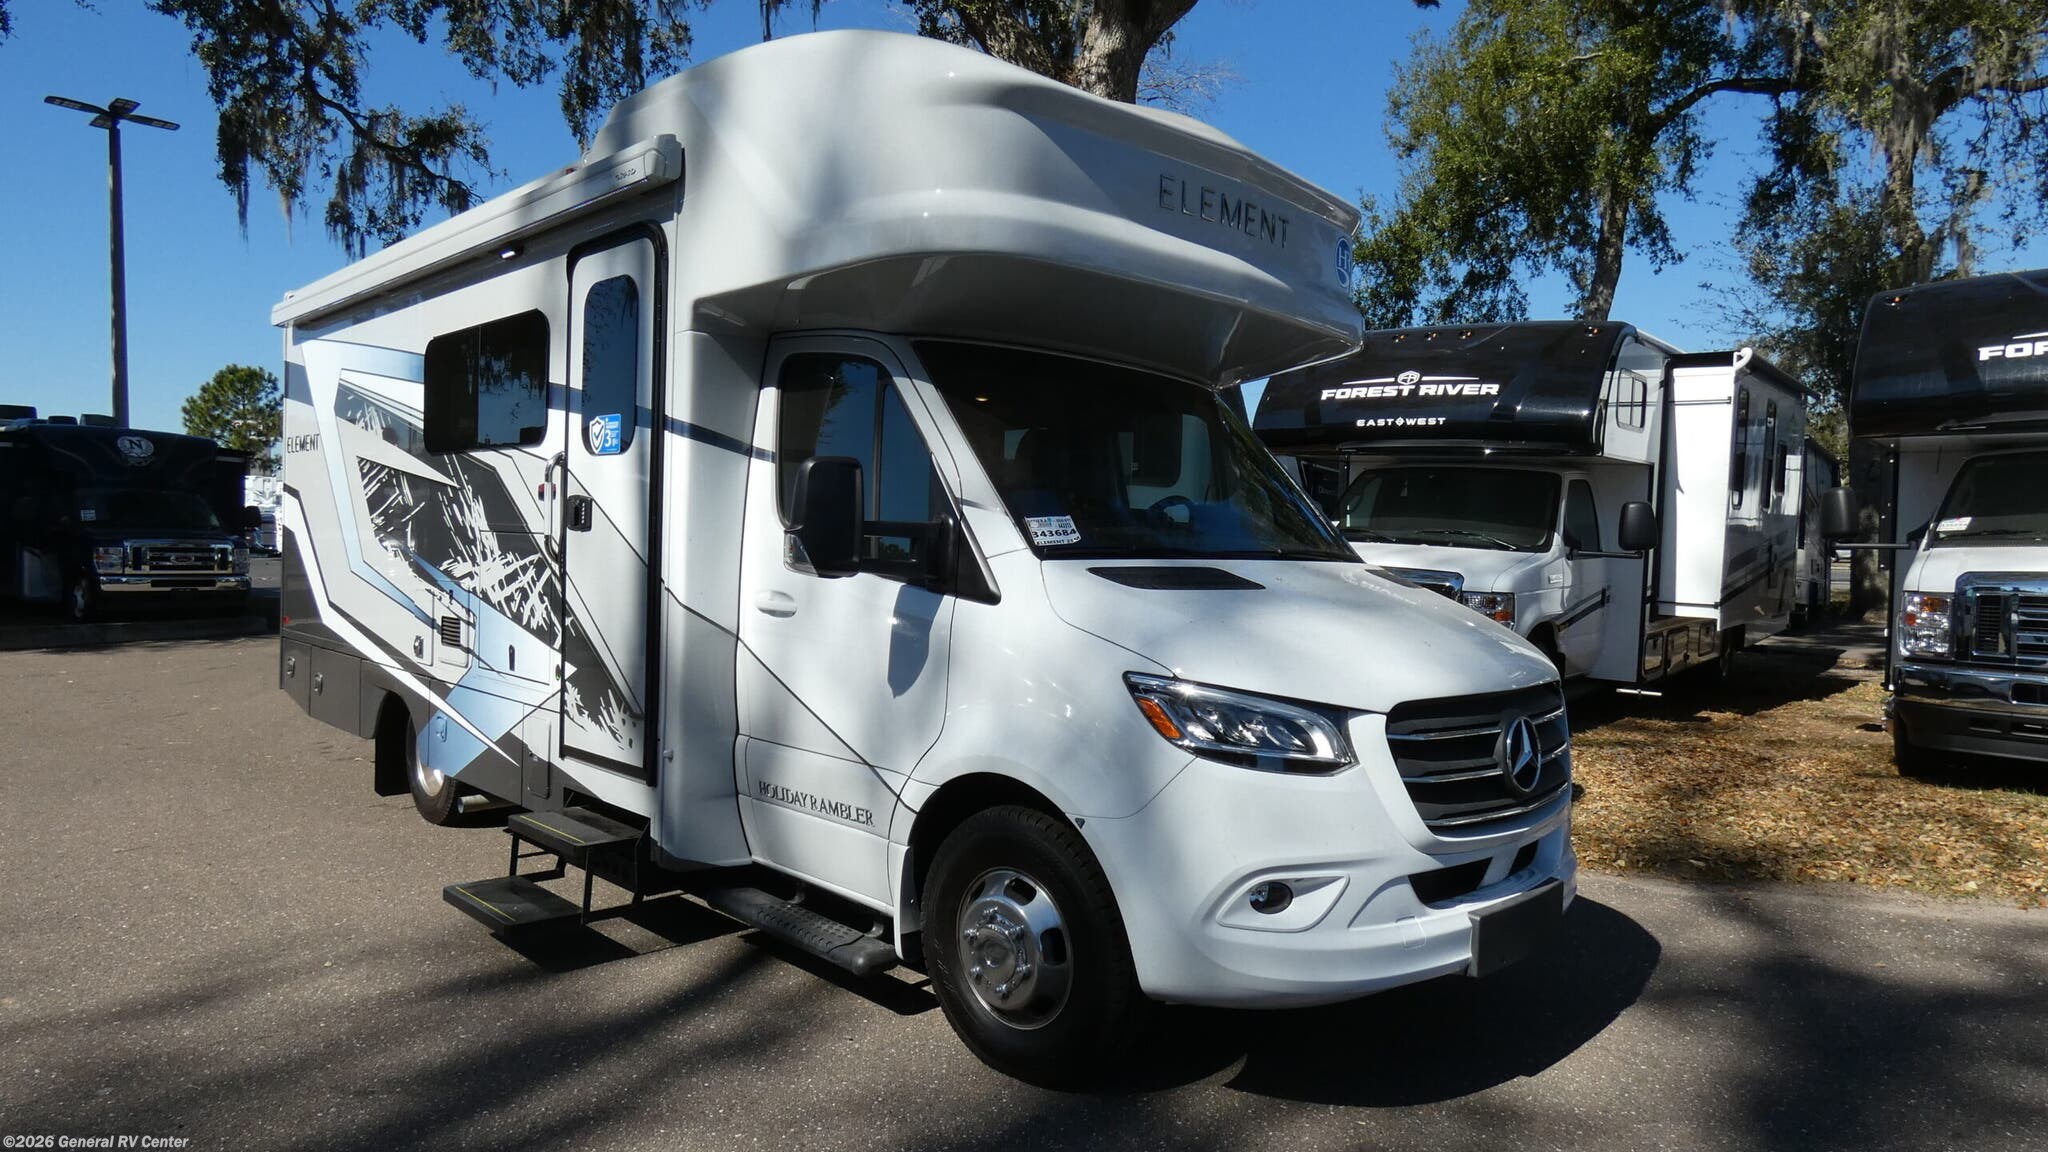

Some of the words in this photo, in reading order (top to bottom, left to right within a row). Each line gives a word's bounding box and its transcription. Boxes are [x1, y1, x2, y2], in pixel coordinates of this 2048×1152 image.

[1158, 173, 1290, 249] ELEMENT
[1320, 385, 1416, 401] FOREST
[1418, 383, 1500, 396] RIVER
[1356, 418, 1395, 427] EAST
[1405, 417, 1446, 426] WEST
[286, 433, 320, 454] ELEMENT
[1031, 528, 1077, 538] 343684
[759, 780, 809, 808] HOLIDAY
[810, 794, 875, 826] RAMBLER
